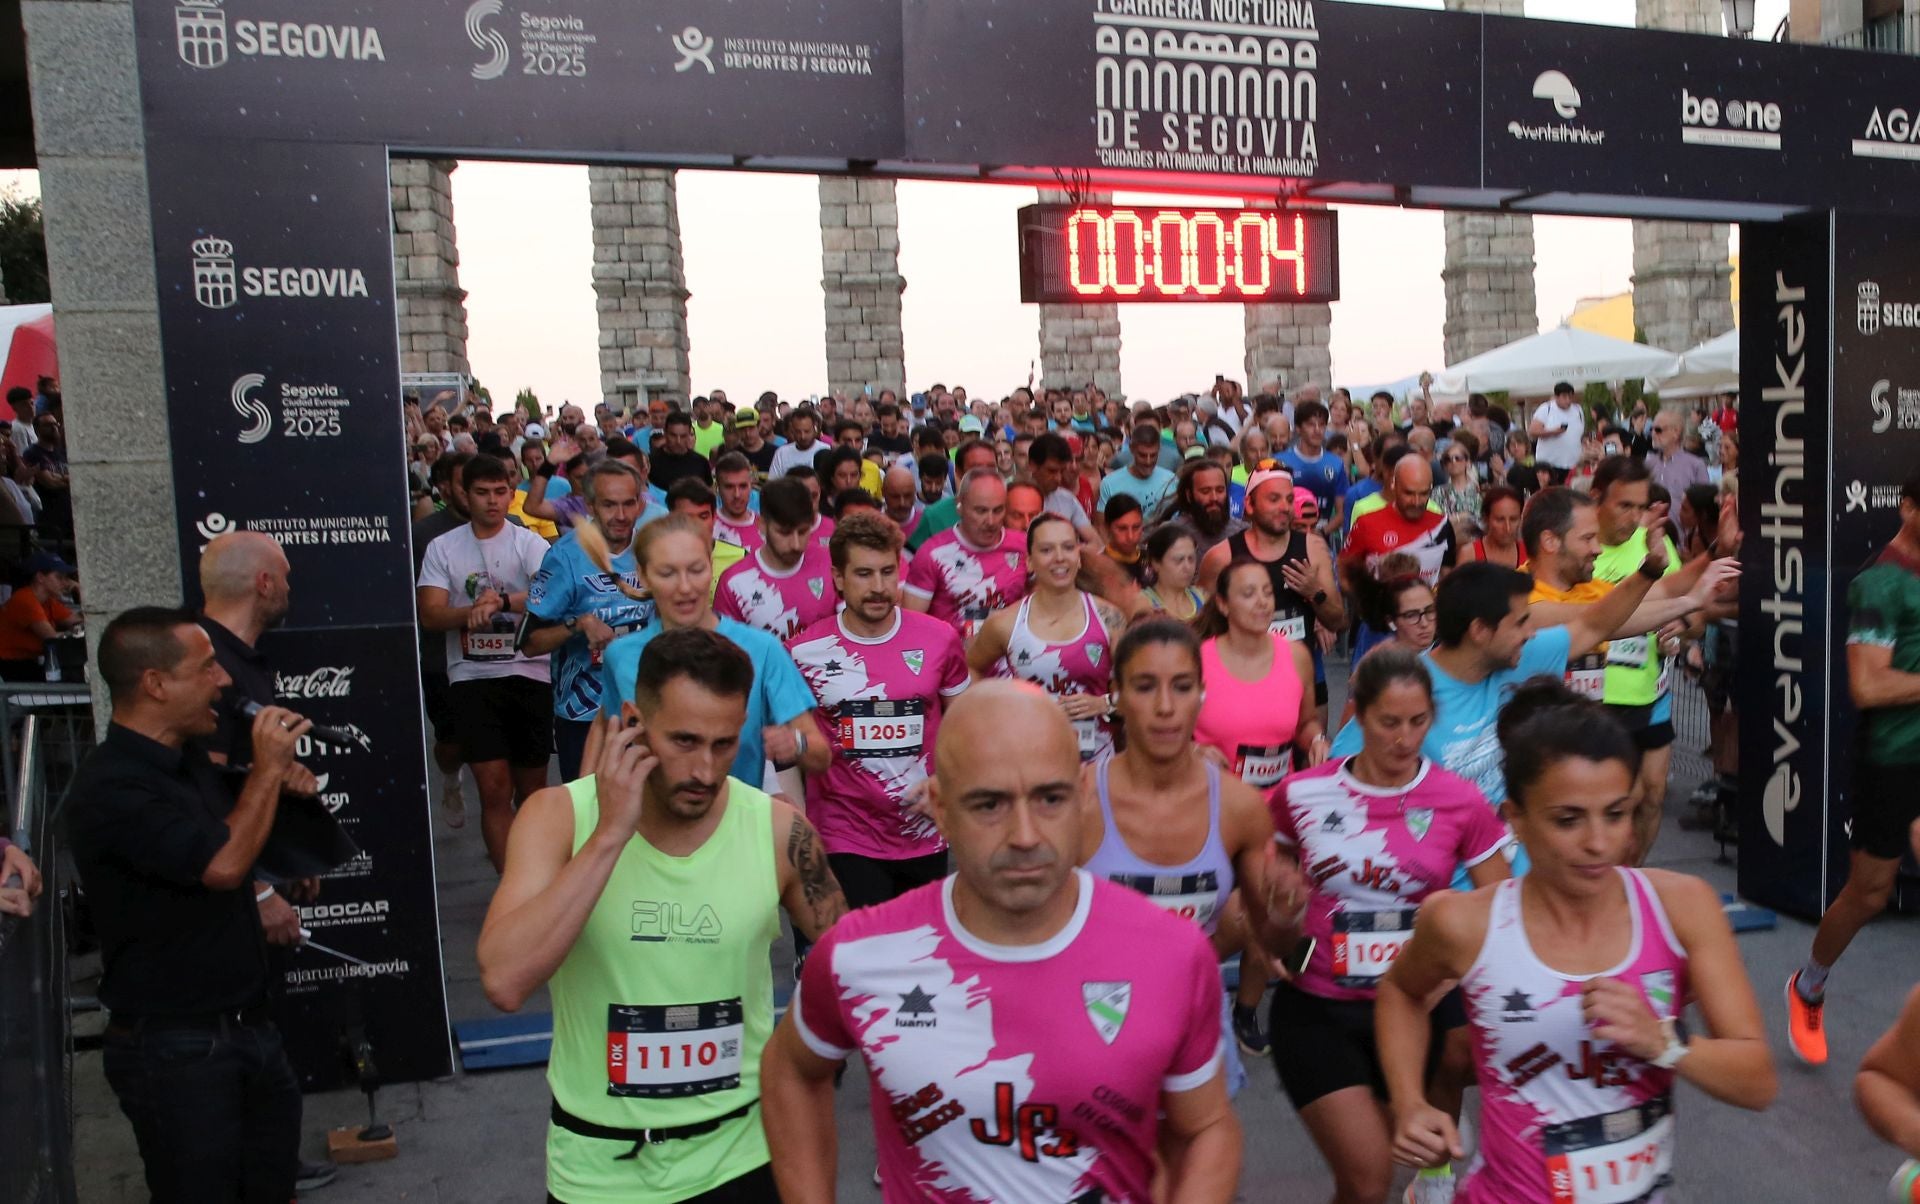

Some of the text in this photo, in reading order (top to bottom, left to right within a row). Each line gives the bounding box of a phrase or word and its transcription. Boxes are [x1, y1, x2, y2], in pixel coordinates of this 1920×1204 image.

[520, 12, 584, 31] Segovia
[1110, 0, 1204, 20] CARRERA
[1210, 0, 1316, 29] NOCTURNA
[235, 19, 386, 62] SEGOVIA
[521, 29, 555, 41] Ciudad
[522, 41, 585, 55] del Deporte
[724, 38, 871, 58] INSTITUTO MUNICIPAL DE
[522, 52, 587, 77] 2025
[724, 52, 799, 72] DEPORTES
[810, 57, 872, 75] SEGOVIA
[1682, 88, 1719, 126] be
[1097, 109, 1318, 160] DE SEGOVIA
[1508, 121, 1605, 145] eventsthinker
[1155, 152, 1219, 171] PATRIMONIO
[1221, 157, 1236, 173] DE
[1237, 158, 1250, 173] LA
[1067, 209, 1305, 296] 00:00:04
[242, 266, 369, 298] SEGOVIA
[281, 383, 338, 399] Segovia
[282, 398, 350, 409] Ciudad Europea
[283, 408, 340, 419] del Deporte
[283, 417, 342, 437] 2025
[1871, 495, 1903, 508] DEPORT
[246, 515, 389, 531] INSTITUTO MUNICIPAL DE
[265, 530, 319, 545] ORTES
[330, 529, 390, 544] SEGOVIA
[1760, 269, 1806, 846] eventsthinker
[470, 638, 503, 649] 1345
[844, 724, 852, 739] 10K
[859, 724, 907, 740] 1205
[302, 915, 387, 928] RECAMBIOS
[631, 900, 723, 936] FILA
[1355, 941, 1408, 963] 102
[285, 957, 410, 983] ajaruralsegovia
[611, 1043, 624, 1067] 10K
[637, 1041, 718, 1070] 1110
